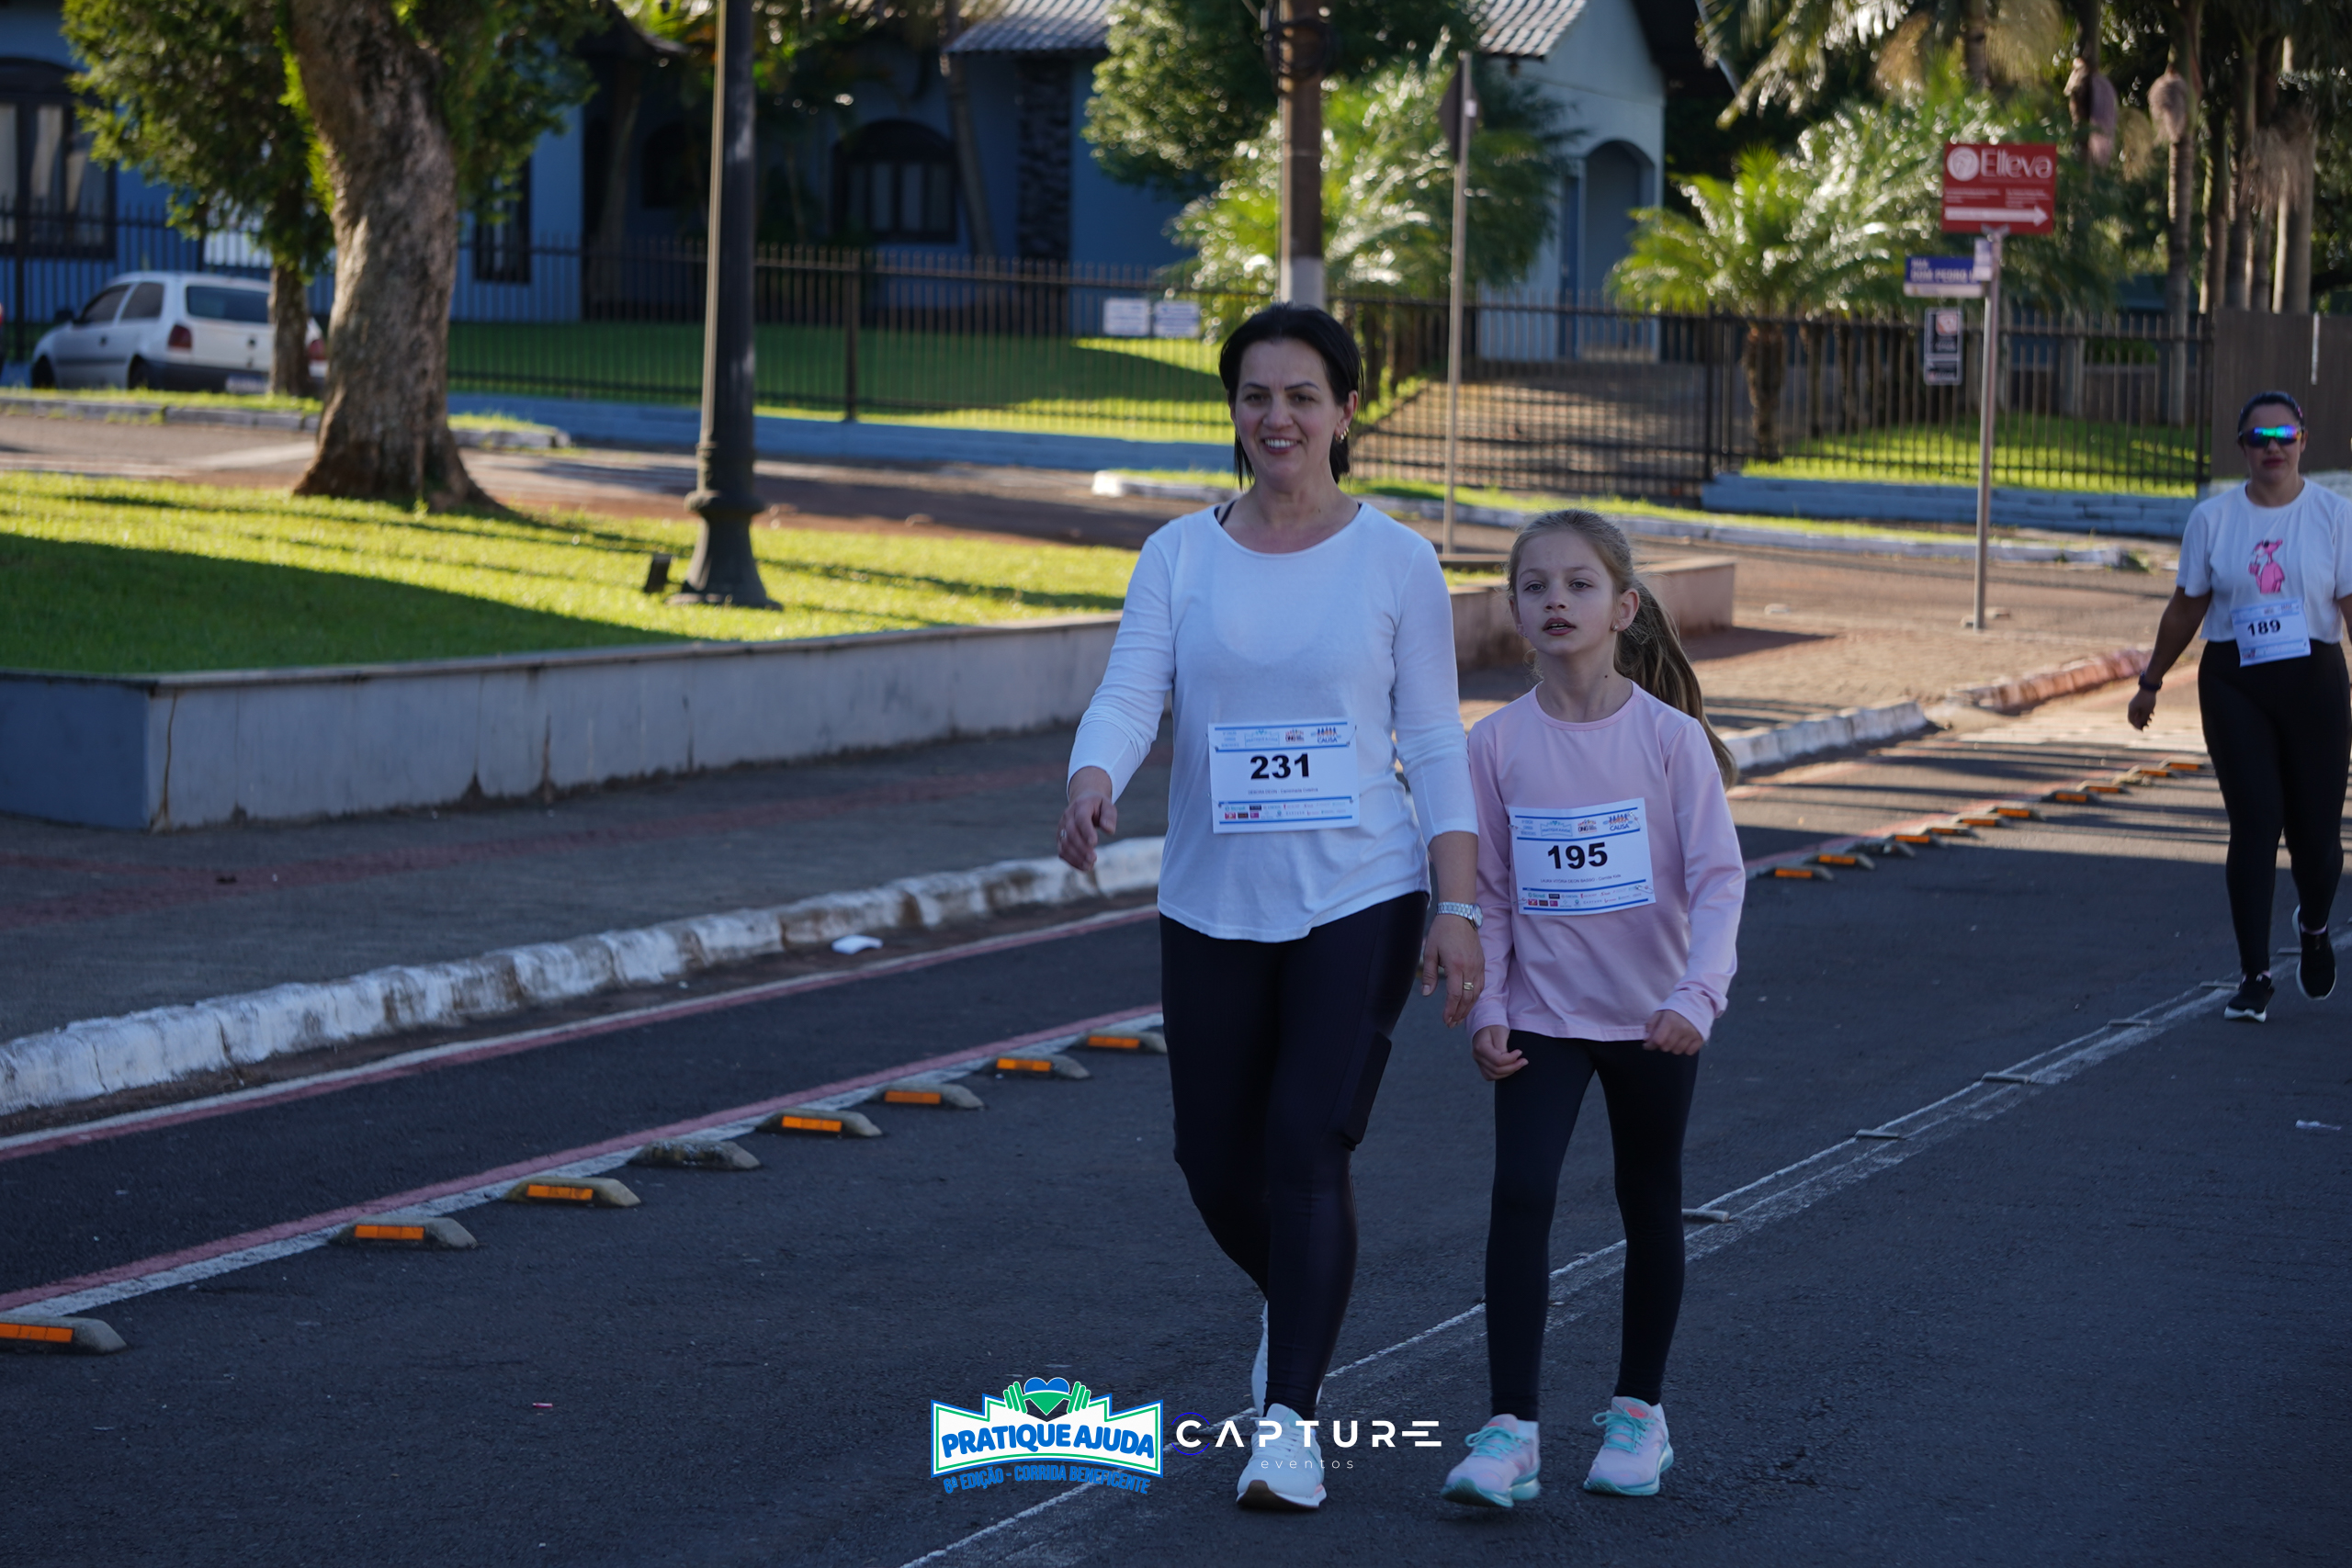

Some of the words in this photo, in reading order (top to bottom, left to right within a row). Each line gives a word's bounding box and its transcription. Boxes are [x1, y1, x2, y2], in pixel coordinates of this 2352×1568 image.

[1981, 148, 2052, 179] Elleva
[2247, 619, 2280, 637] 189
[1250, 753, 1309, 780] 231
[1610, 823, 1630, 831] CAUSA
[1548, 841, 1608, 869] 195
